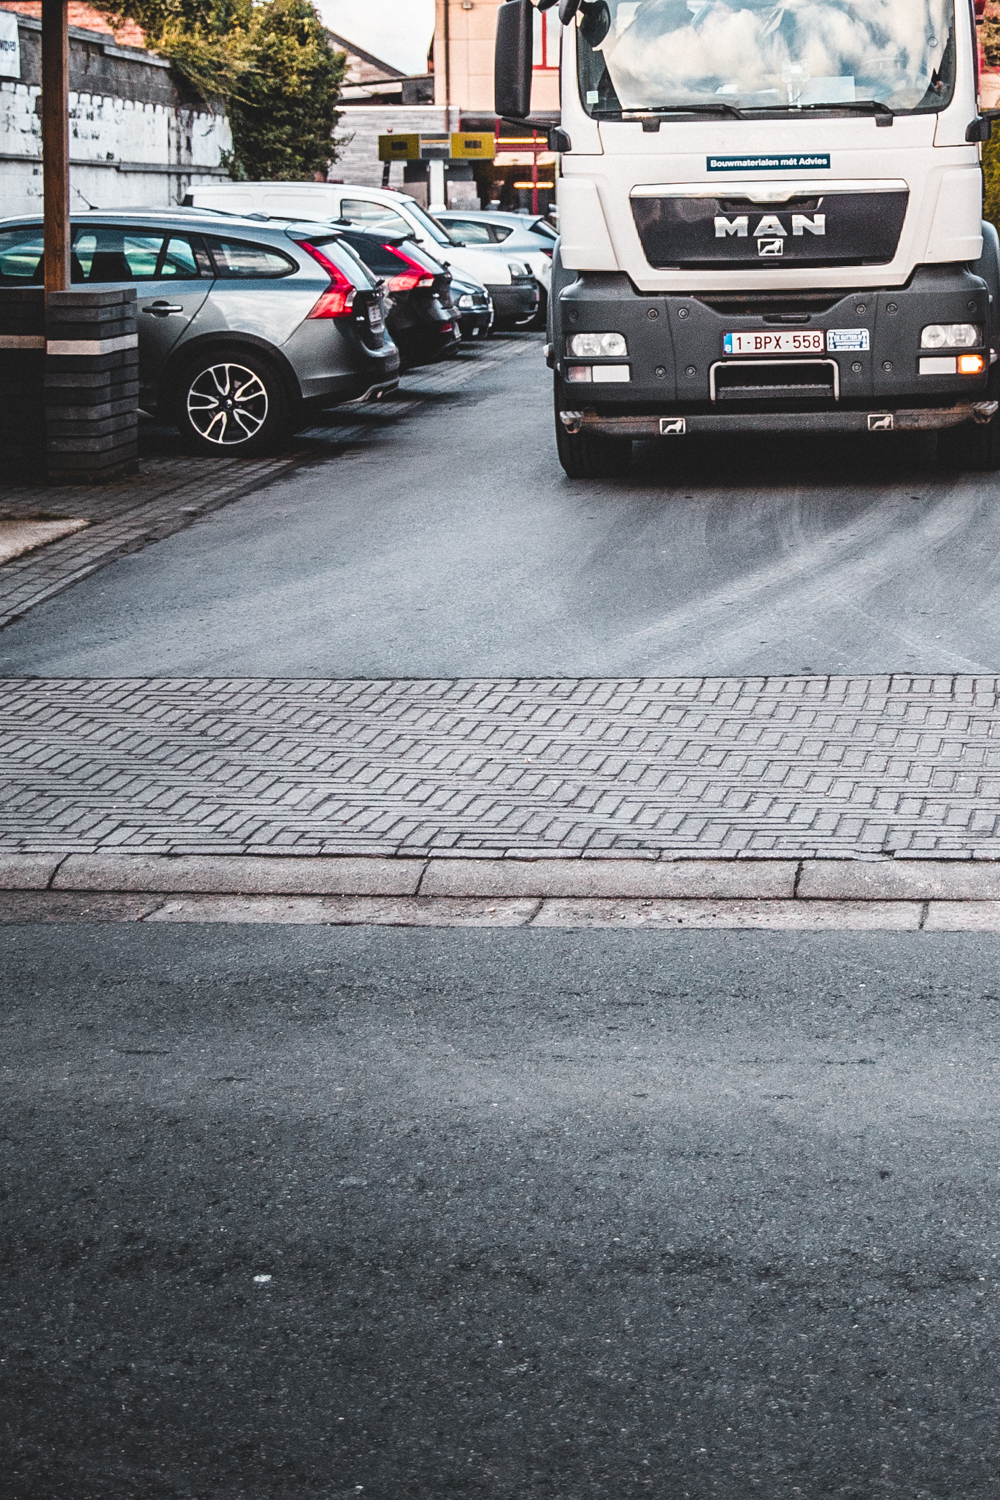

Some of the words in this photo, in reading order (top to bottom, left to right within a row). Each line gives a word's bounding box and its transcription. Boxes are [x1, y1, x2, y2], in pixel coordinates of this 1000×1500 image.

[710, 158, 779, 168] Bouwmaterialen
[799, 156, 827, 166] Advies
[714, 214, 826, 238] MAN
[736, 334, 821, 351] 1-BPX-558
